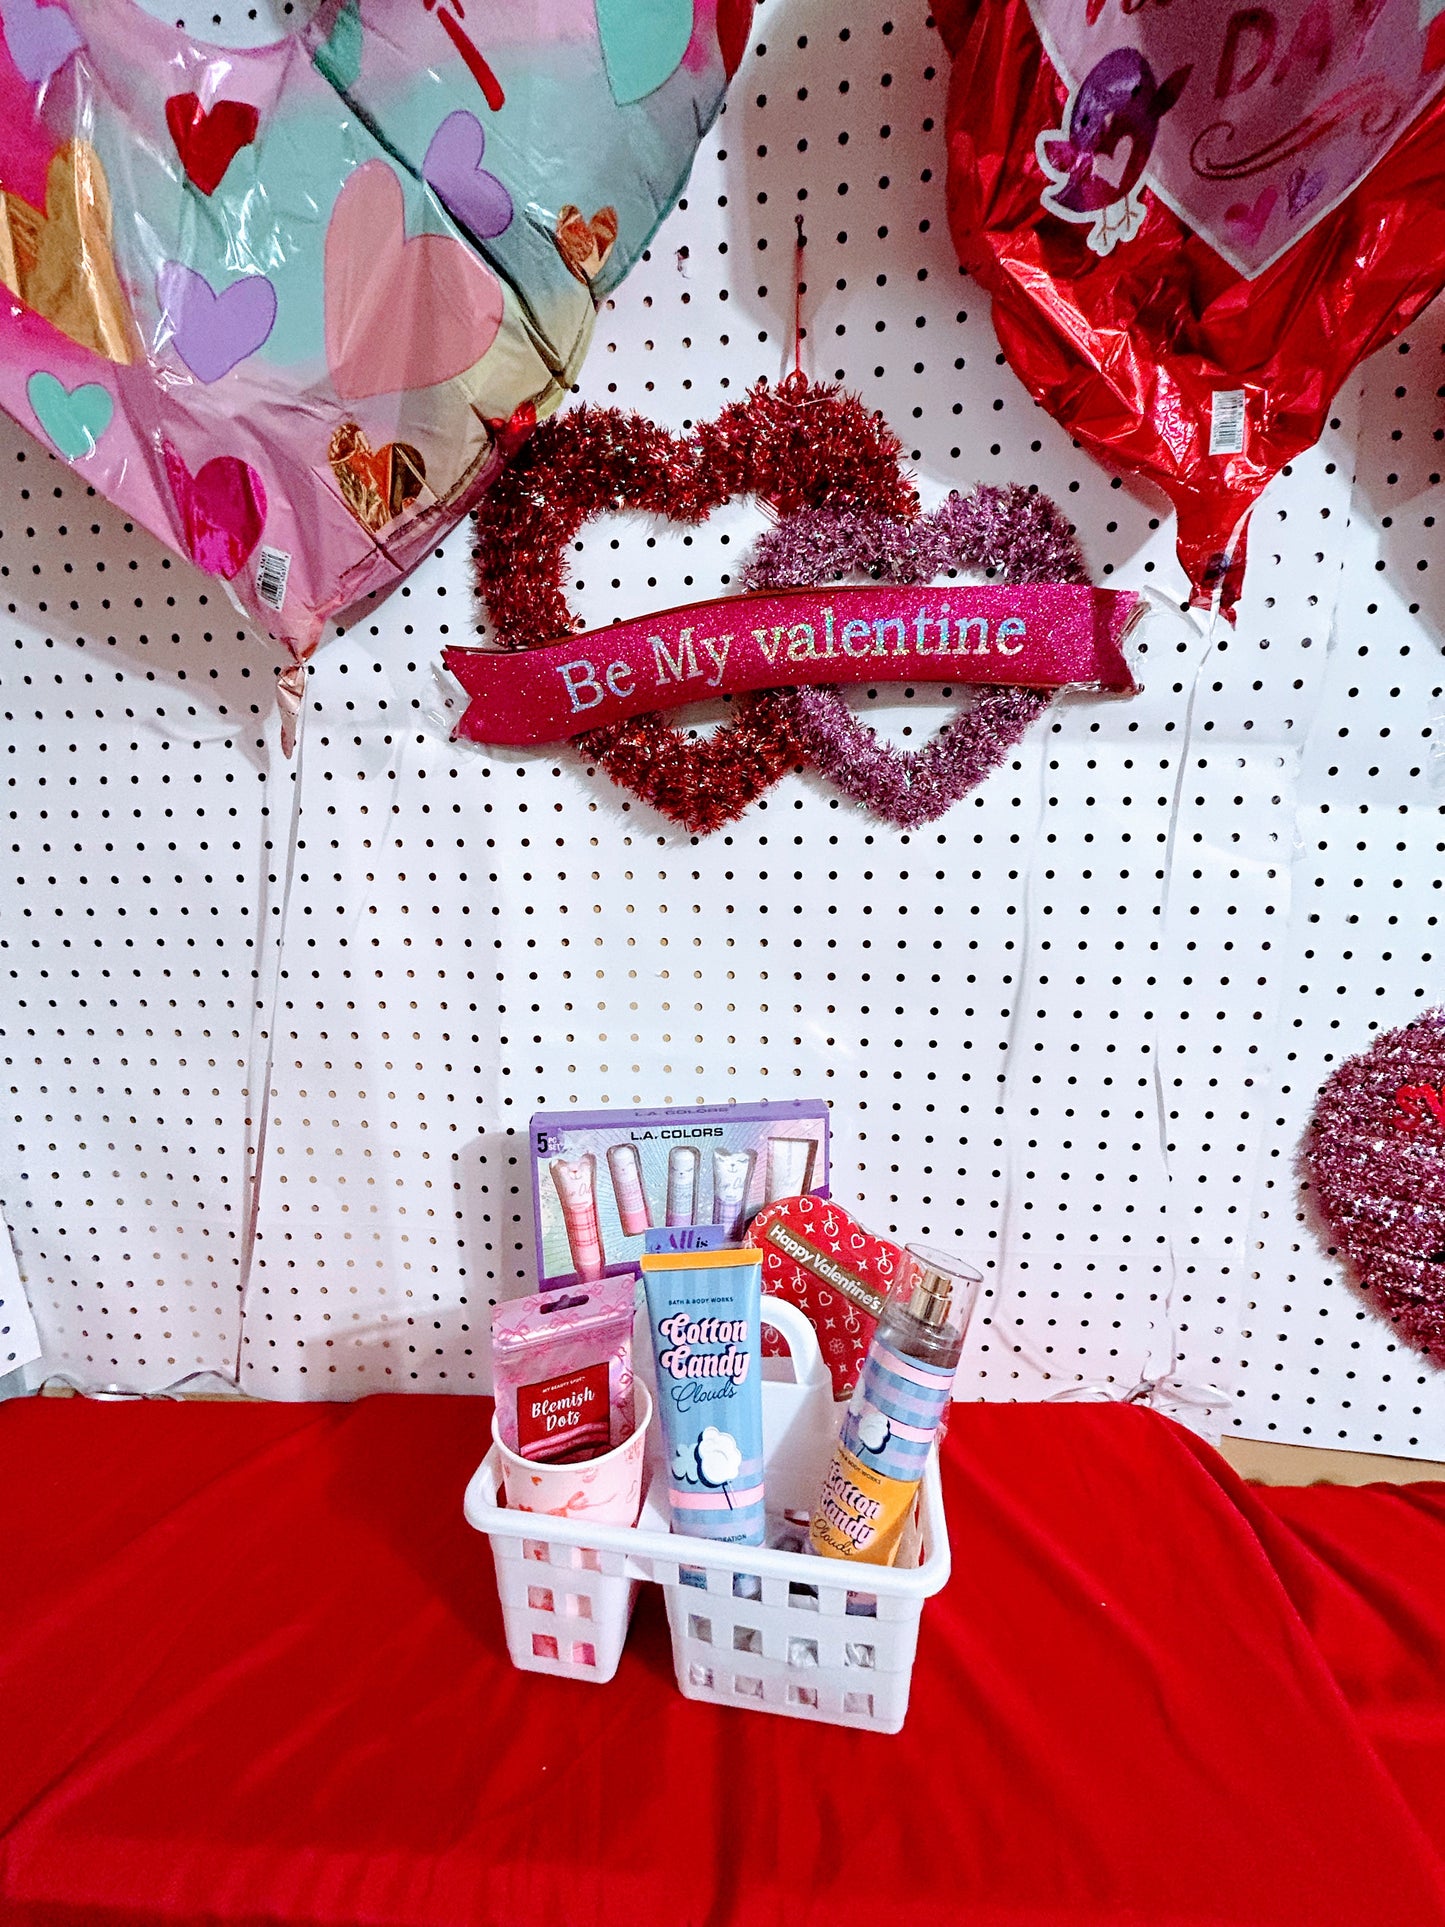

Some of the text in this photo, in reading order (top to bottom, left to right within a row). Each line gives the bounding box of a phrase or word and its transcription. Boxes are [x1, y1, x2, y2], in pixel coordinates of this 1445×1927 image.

[556, 603, 1027, 714] Be My valentine
[537, 1132, 548, 1154] 5
[630, 1127, 724, 1141] L.A. COLORS
[770, 1224, 883, 1311] Happy Valentine's
[658, 1312, 749, 1346] Cotton
[659, 1344, 751, 1386] Candy
[531, 1386, 596, 1419] Blemish
[671, 1380, 738, 1413] Clouds
[546, 1410, 582, 1432] Dots
